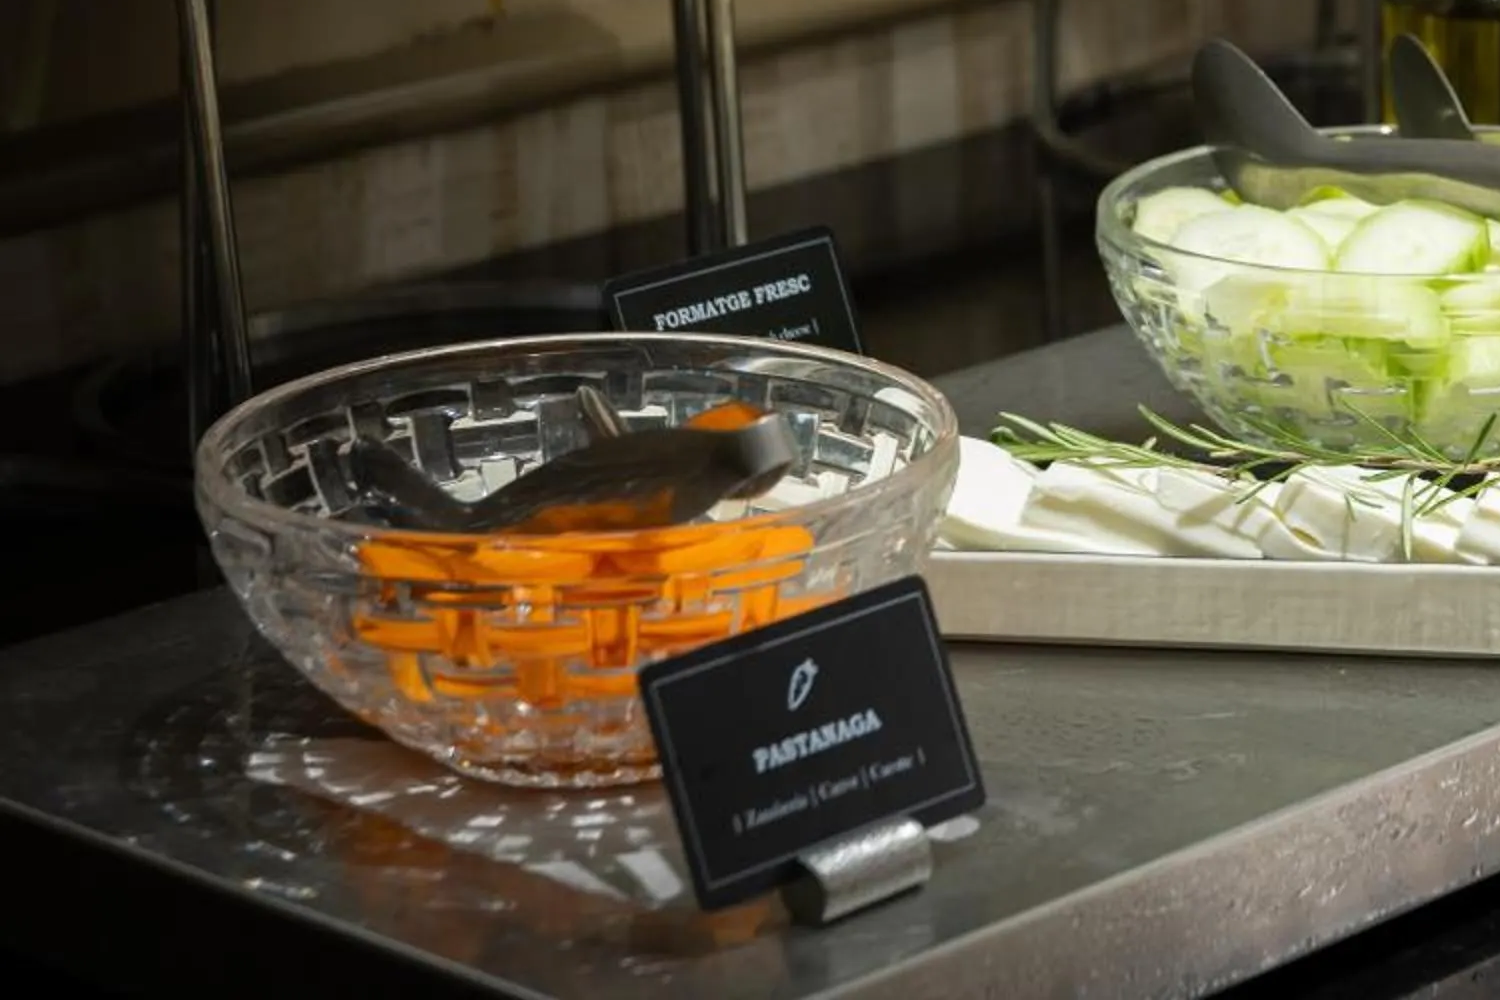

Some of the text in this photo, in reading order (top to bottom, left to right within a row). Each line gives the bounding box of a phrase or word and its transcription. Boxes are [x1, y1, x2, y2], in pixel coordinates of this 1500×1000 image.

[653, 274, 811, 331] FORMATGE FRESC
[753, 708, 882, 774] PASTANAGA
